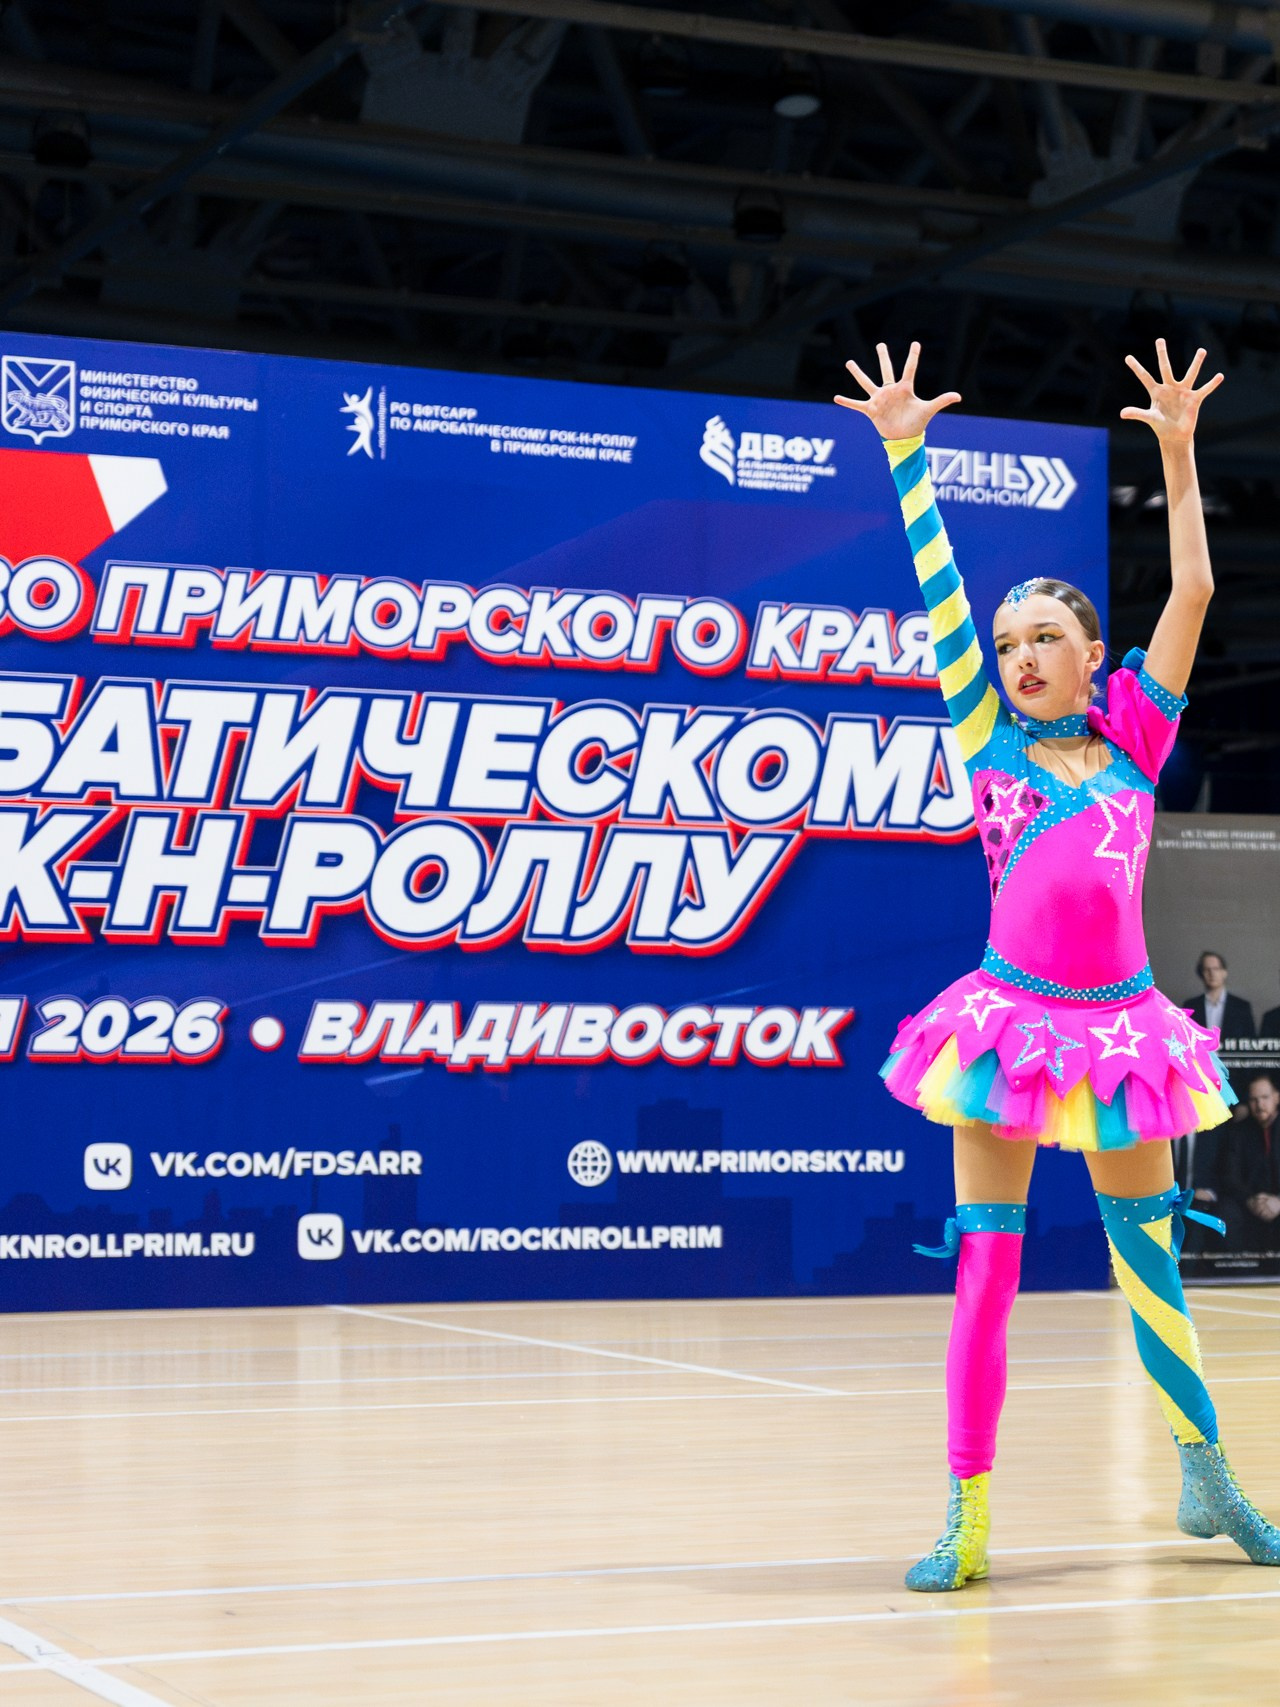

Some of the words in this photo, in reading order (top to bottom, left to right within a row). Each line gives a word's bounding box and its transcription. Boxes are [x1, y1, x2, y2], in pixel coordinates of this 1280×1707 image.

[80, 369, 198, 392] МИНИСТЕРСТВО
[80, 385, 180, 406] ФИЗИЧЕСКОЙ
[182, 393, 258, 412] КУЛЬТУРЫ
[80, 400, 91, 414] И
[94, 401, 153, 419] СПОРТА
[390, 401, 411, 416] РО
[80, 415, 189, 437] ПРИМОРСКОГО
[192, 424, 230, 440] КРАЯ
[390, 416, 412, 431] ПО
[413, 418, 548, 442] АКРОБАТИЧЕСКОМУ
[549, 429, 638, 449] РОК-Н-РОЛЛУ
[490, 439, 502, 453] В
[503, 440, 597, 461] ПРИМОРСКОМ
[598, 448, 633, 464] КРАЕ
[737, 432, 835, 463] ДВФУ
[925, 447, 1030, 491] ТАНЬ
[935, 485, 1028, 507] ПИОНОМ
[91, 560, 743, 668] ПРИМОРСКОГО
[748, 601, 939, 681] КРАЯ
[0, 804, 802, 950] К-Н-РОЛЛУ
[27, 995, 228, 1062] 2026
[298, 1000, 852, 1068] ВЛАДИВОСТОК
[150, 1147, 423, 1179] VK.COM/FDSARR
[616, 1150, 905, 1173] WWW.PRIMORSKY.RU
[0, 1232, 255, 1259] KNROLLPRIM.RU
[351, 1225, 723, 1253] VK.COM/ROCKNROLLPRIM
